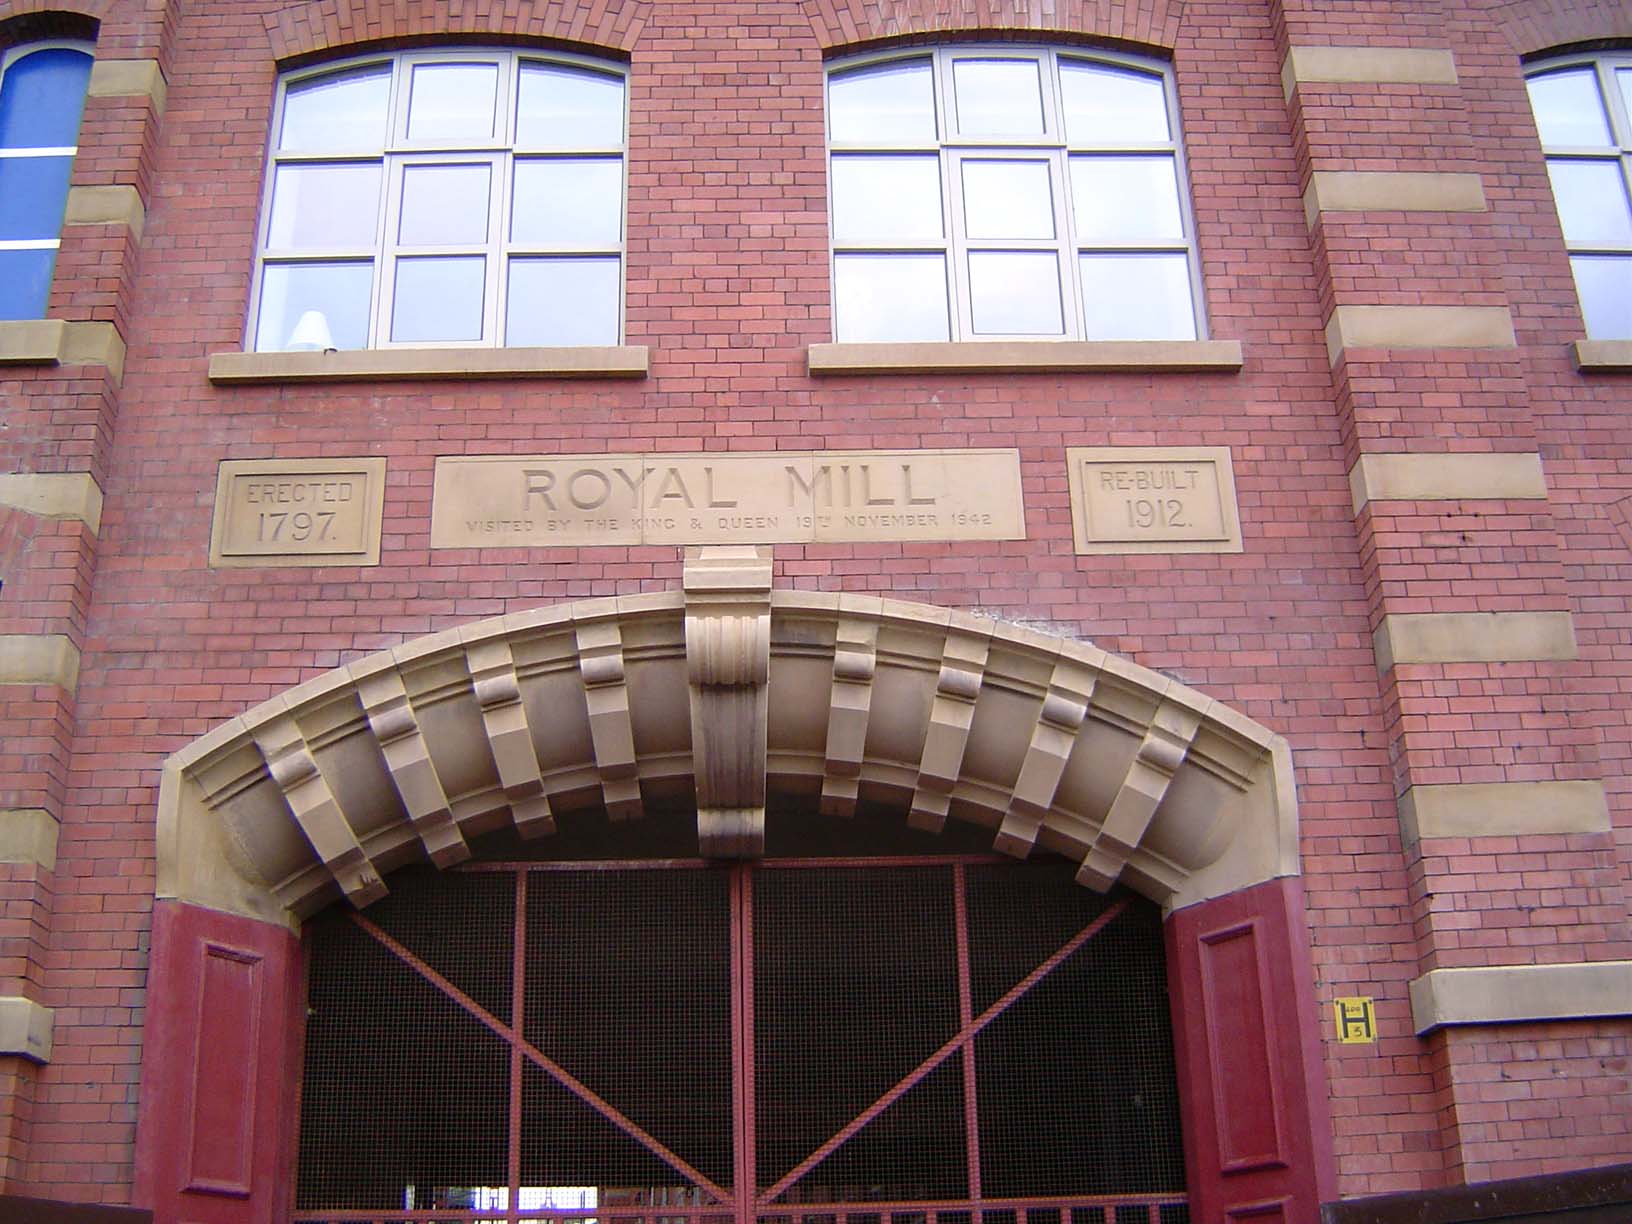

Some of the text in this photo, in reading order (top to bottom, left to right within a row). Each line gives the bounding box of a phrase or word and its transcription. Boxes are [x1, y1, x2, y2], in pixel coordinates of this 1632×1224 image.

[521, 465, 936, 512] ROYAL MILL
[1099, 470, 1199, 491] RE-BUILT
[247, 482, 353, 503] ERECTED
[466, 520, 532, 532] VISITED
[549, 519, 571, 531] BY
[586, 519, 619, 531] THE
[632, 518, 675, 530] KING
[690, 518, 703, 530] &
[718, 517, 779, 530] QUEEN
[844, 514, 938, 527] NOVEMBER
[951, 513, 992, 525] 1942
[1340, 1002, 1371, 1038] H
